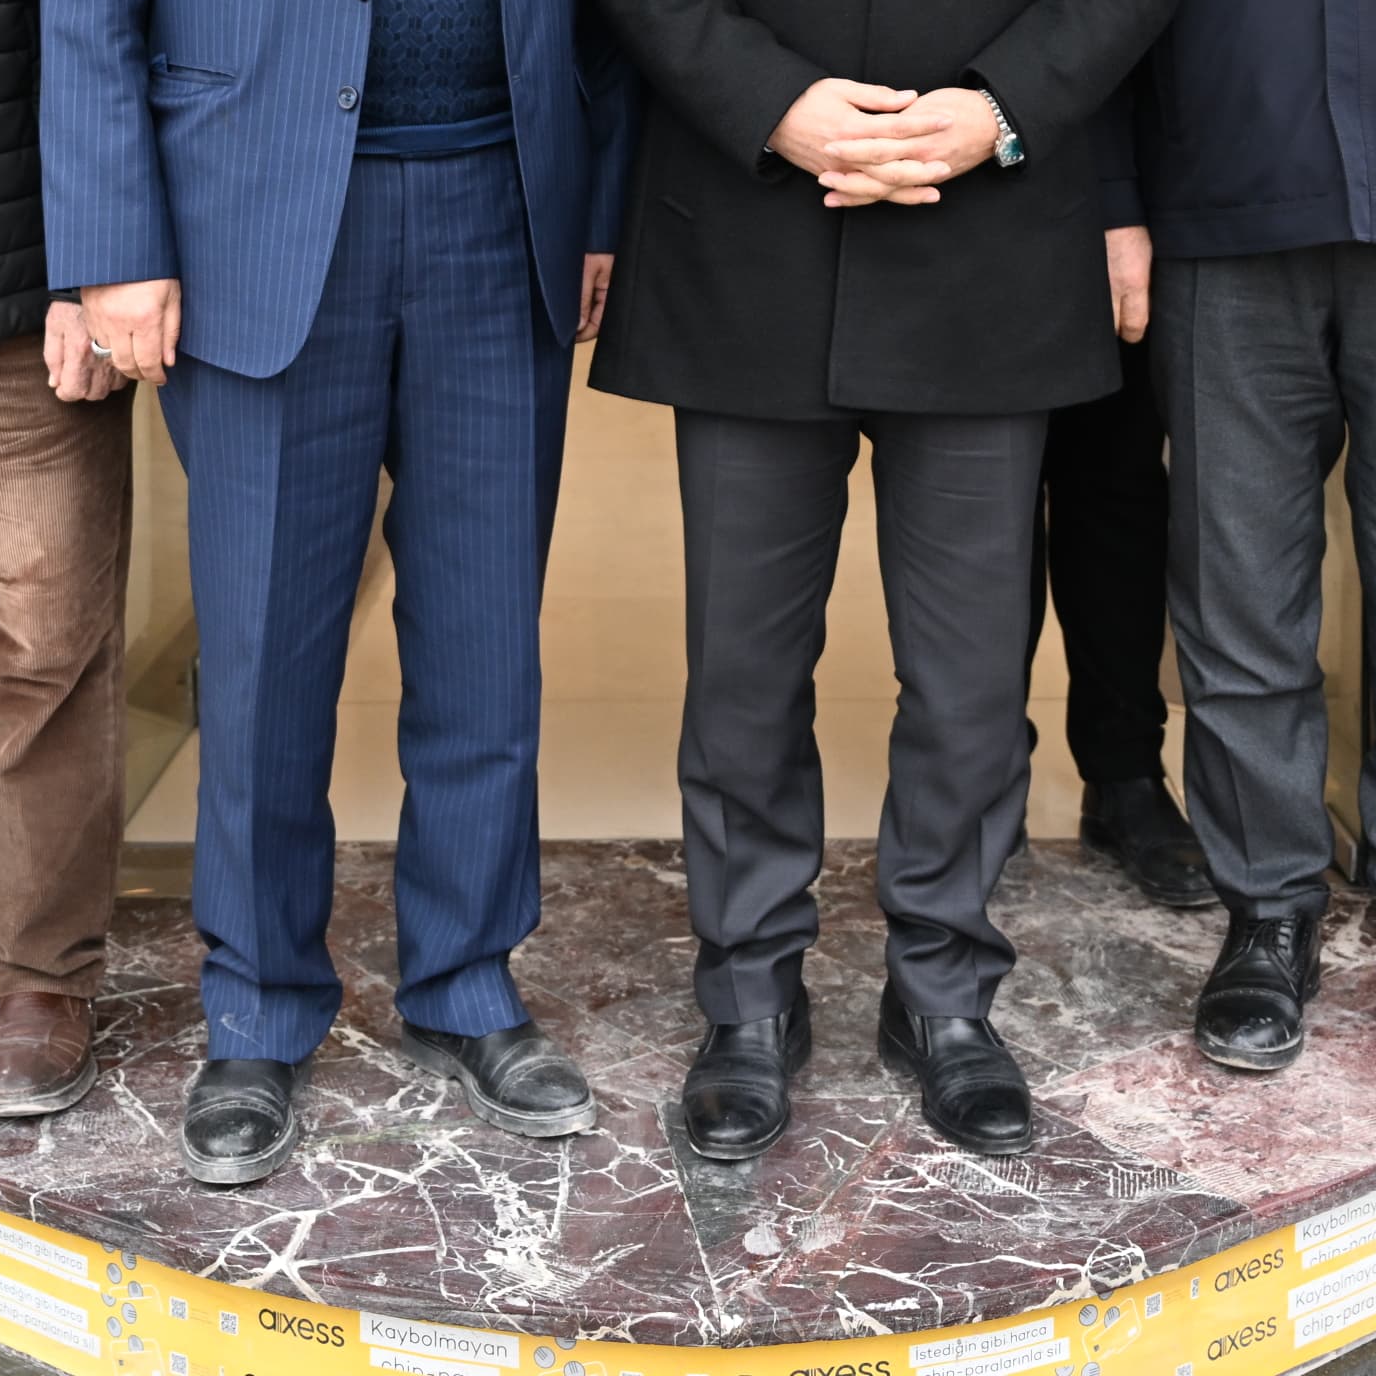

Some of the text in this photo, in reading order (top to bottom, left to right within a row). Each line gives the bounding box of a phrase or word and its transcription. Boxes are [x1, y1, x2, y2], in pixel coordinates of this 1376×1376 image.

[1213, 1247, 1286, 1294] axess
[257, 1307, 346, 1349] axess
[980, 1335, 1007, 1353] gibi
[1009, 1324, 1048, 1344] harca
[1206, 1315, 1278, 1362] axess
[1301, 1295, 1375, 1339] chip-para
[370, 1318, 509, 1361] Kaybolmayan
[1045, 1342, 1063, 1358] sil
